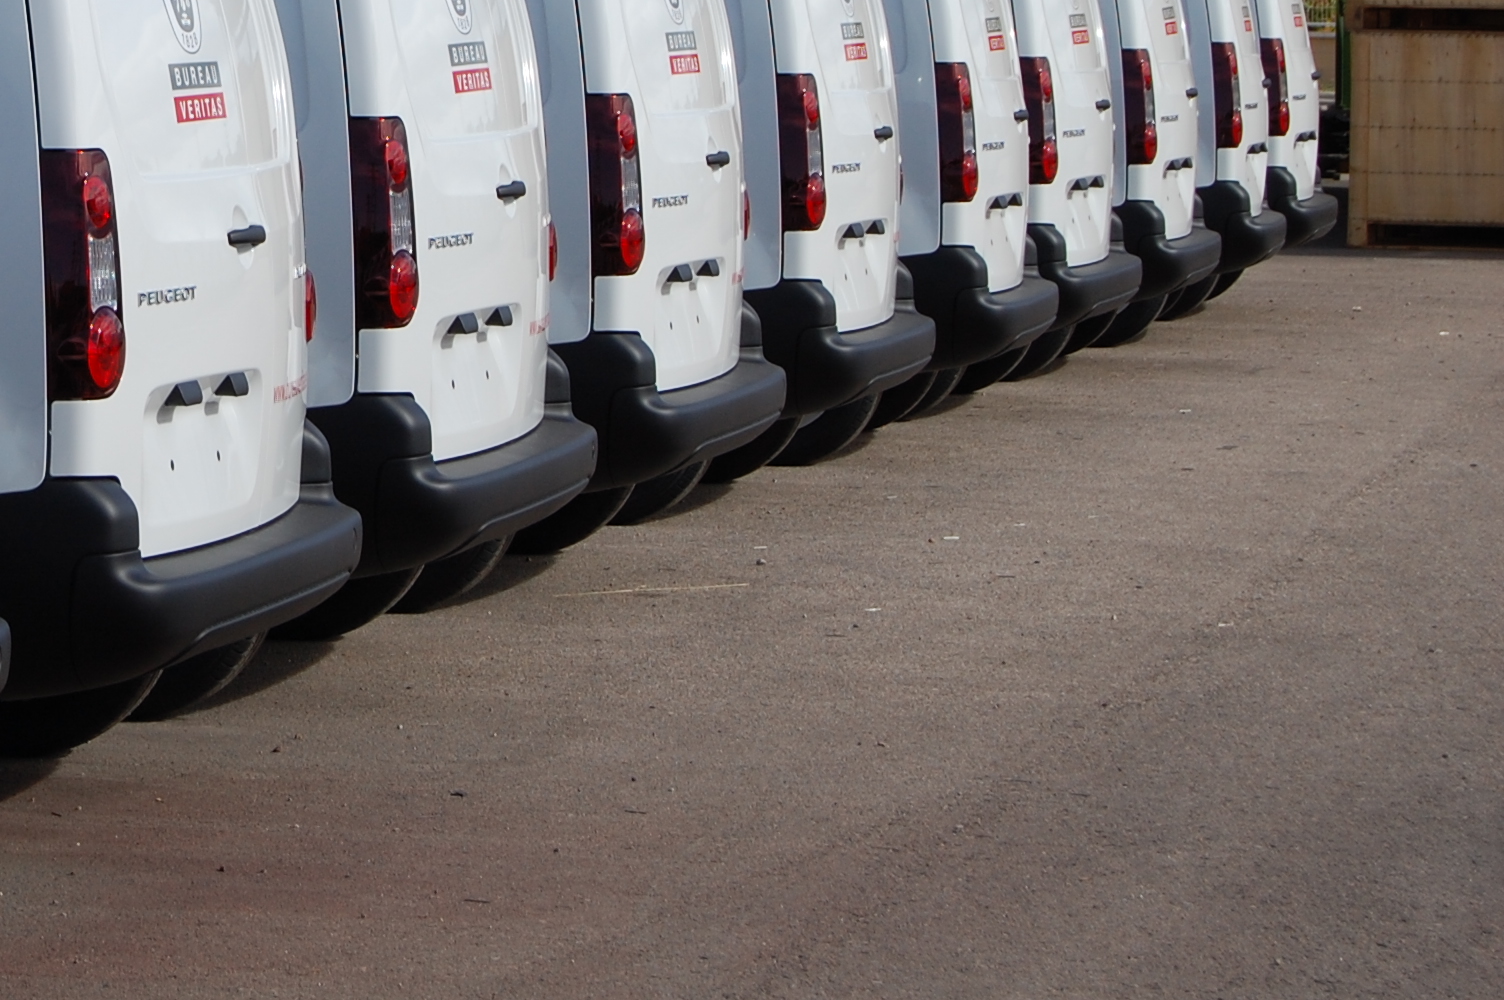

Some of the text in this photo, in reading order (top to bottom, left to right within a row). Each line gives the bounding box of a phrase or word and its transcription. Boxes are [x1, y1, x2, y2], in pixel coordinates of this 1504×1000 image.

[451, 44, 486, 64] BUREAU
[173, 64, 218, 87] BUREAU
[456, 70, 490, 91] VERITAS
[179, 96, 223, 120] VERITAS
[137, 286, 197, 307] PEUGEOT
